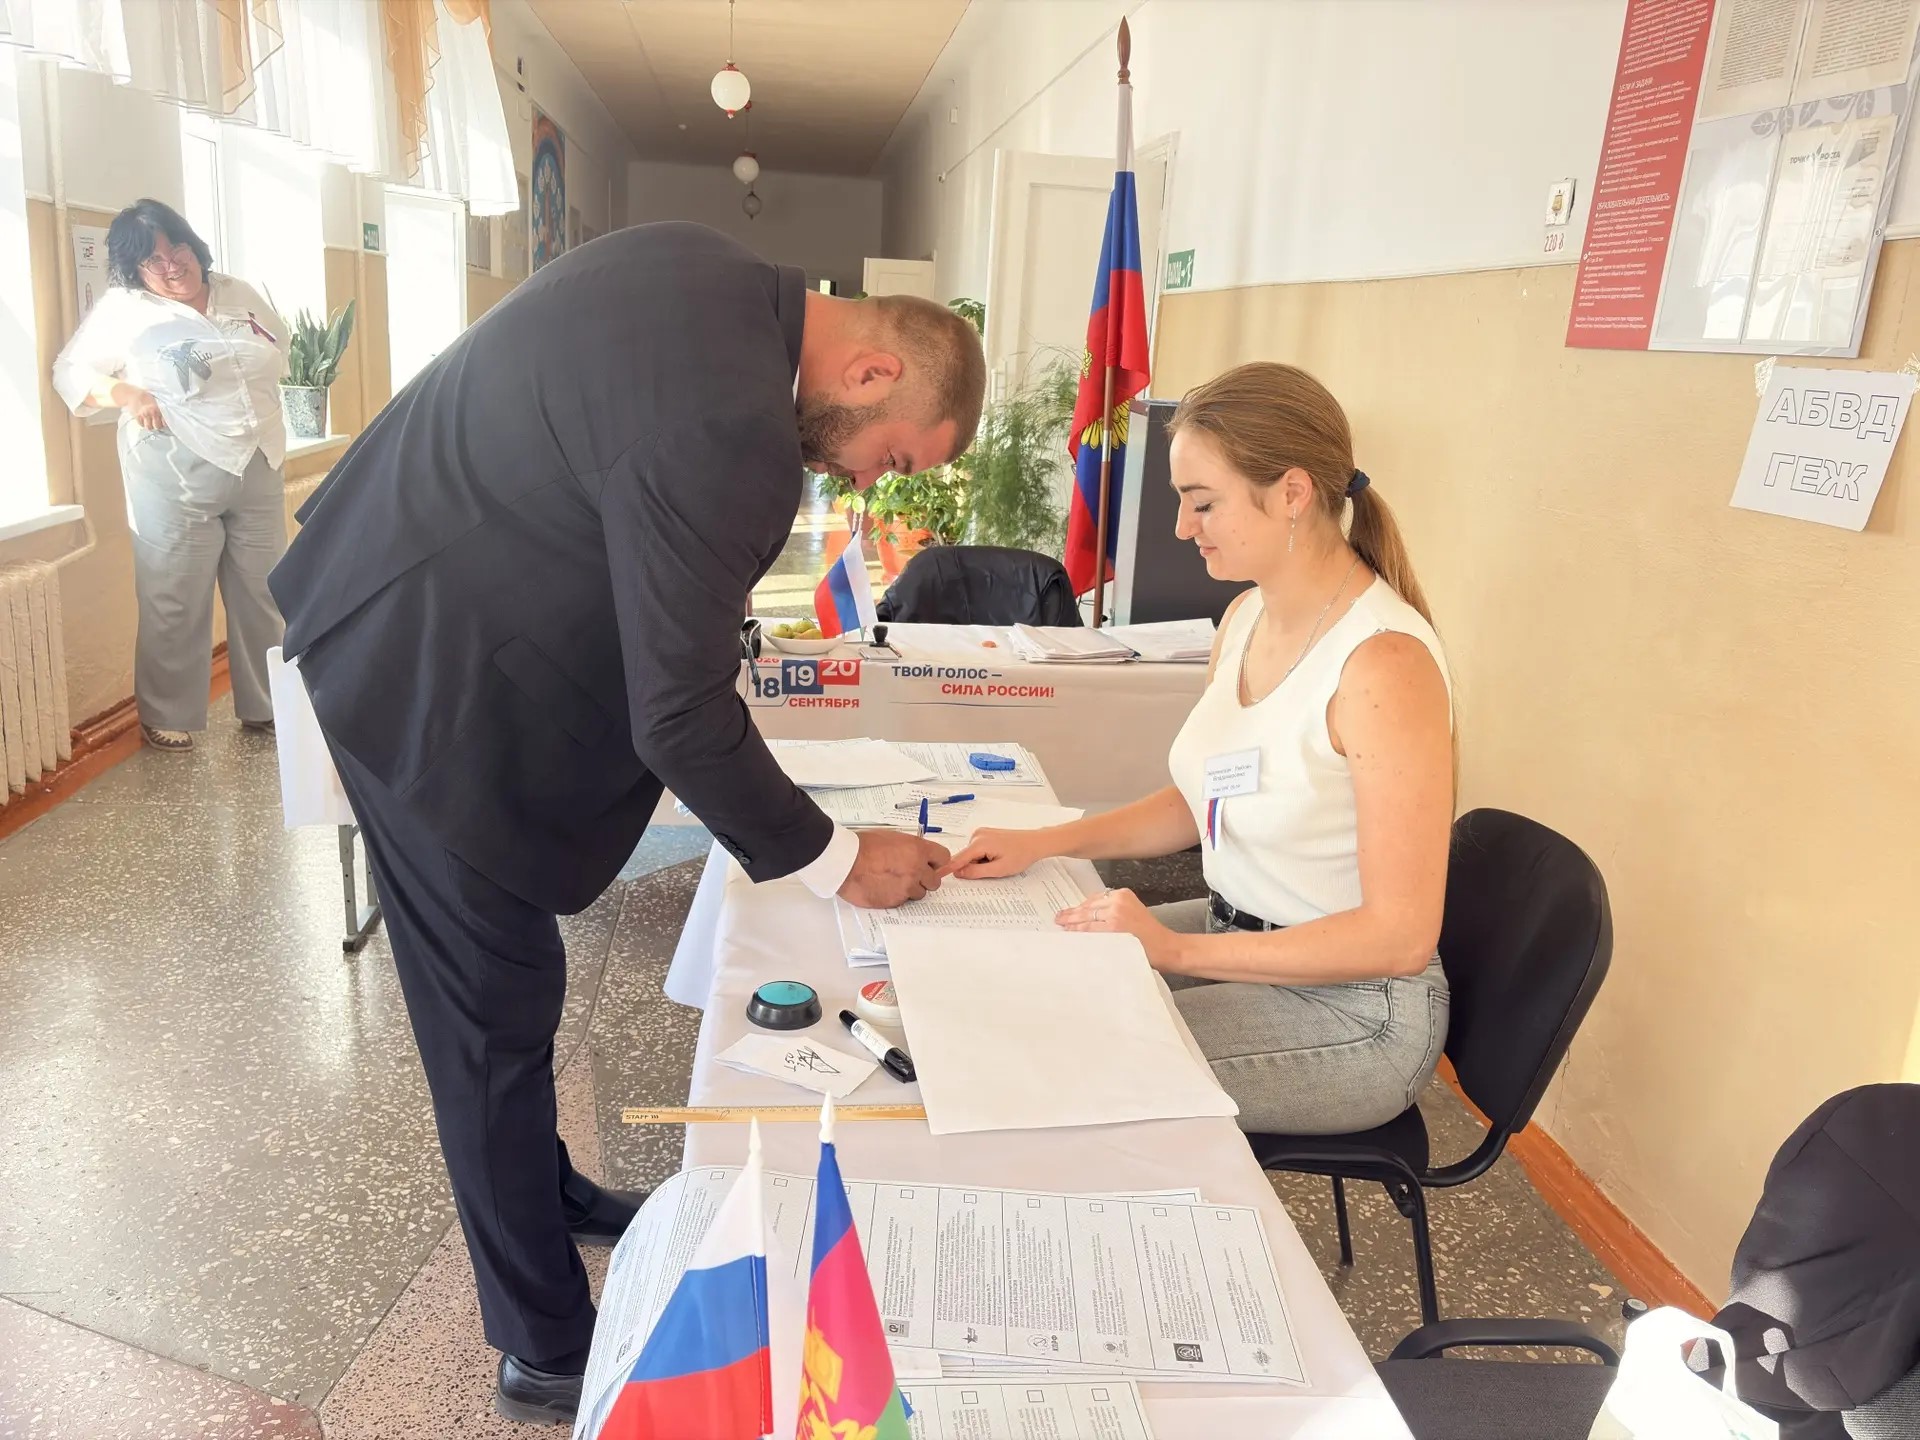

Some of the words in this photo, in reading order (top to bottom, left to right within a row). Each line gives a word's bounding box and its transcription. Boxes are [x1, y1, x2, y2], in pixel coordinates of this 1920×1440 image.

[1766, 388, 1900, 443] АБВД
[1763, 452, 1869, 502] ГЕЖ
[786, 665, 815, 687] 19
[821, 660, 857, 677] 20
[892, 664, 933, 677] ТВОЙ
[937, 667, 988, 679] ГОЛОС
[755, 677, 780, 698] 18
[941, 683, 983, 696] СИЛА
[987, 685, 1055, 698] РОССИИ!
[789, 697, 860, 708] СЕНТЯБРЯ
